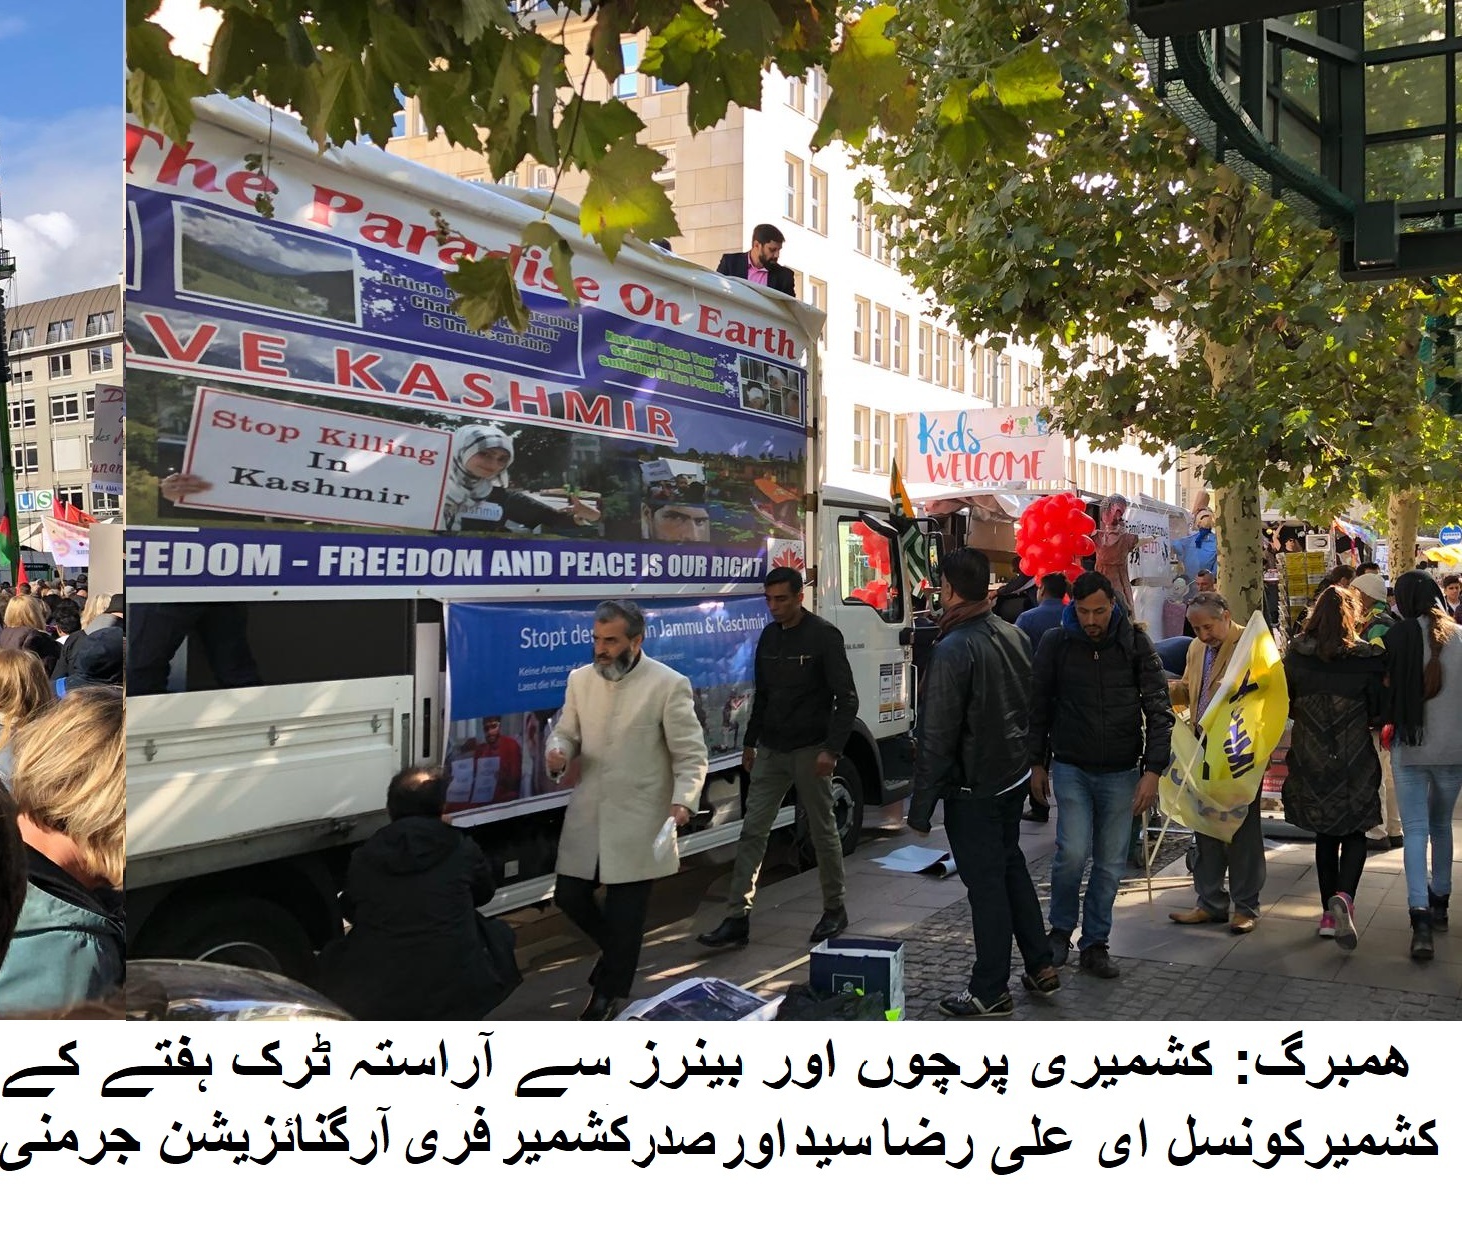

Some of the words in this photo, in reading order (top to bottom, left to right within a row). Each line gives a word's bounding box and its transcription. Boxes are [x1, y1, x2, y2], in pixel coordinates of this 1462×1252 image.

[381, 272, 444, 298] Article
[423, 314, 440, 328] Is
[619, 283, 682, 326] On
[697, 304, 796, 360] Earth
[335, 347, 676, 438] KASHMIR
[211, 409, 301, 443] Stop
[316, 426, 438, 467] Killing
[917, 411, 981, 457] Kids
[307, 450, 350, 474] In
[926, 450, 1046, 483] WELCOME
[229, 466, 410, 506] Kashmir
[319, 546, 484, 577] FREEDOM
[490, 549, 553, 577] AND
[560, 551, 636, 577] PEACE
[642, 553, 660, 577] IS
[668, 554, 707, 577] OUR
[710, 556, 763, 578] RIGHT
[520, 626, 568, 651] Stopt
[660, 619, 704, 638] Jammu
[706, 616, 716, 634] &
